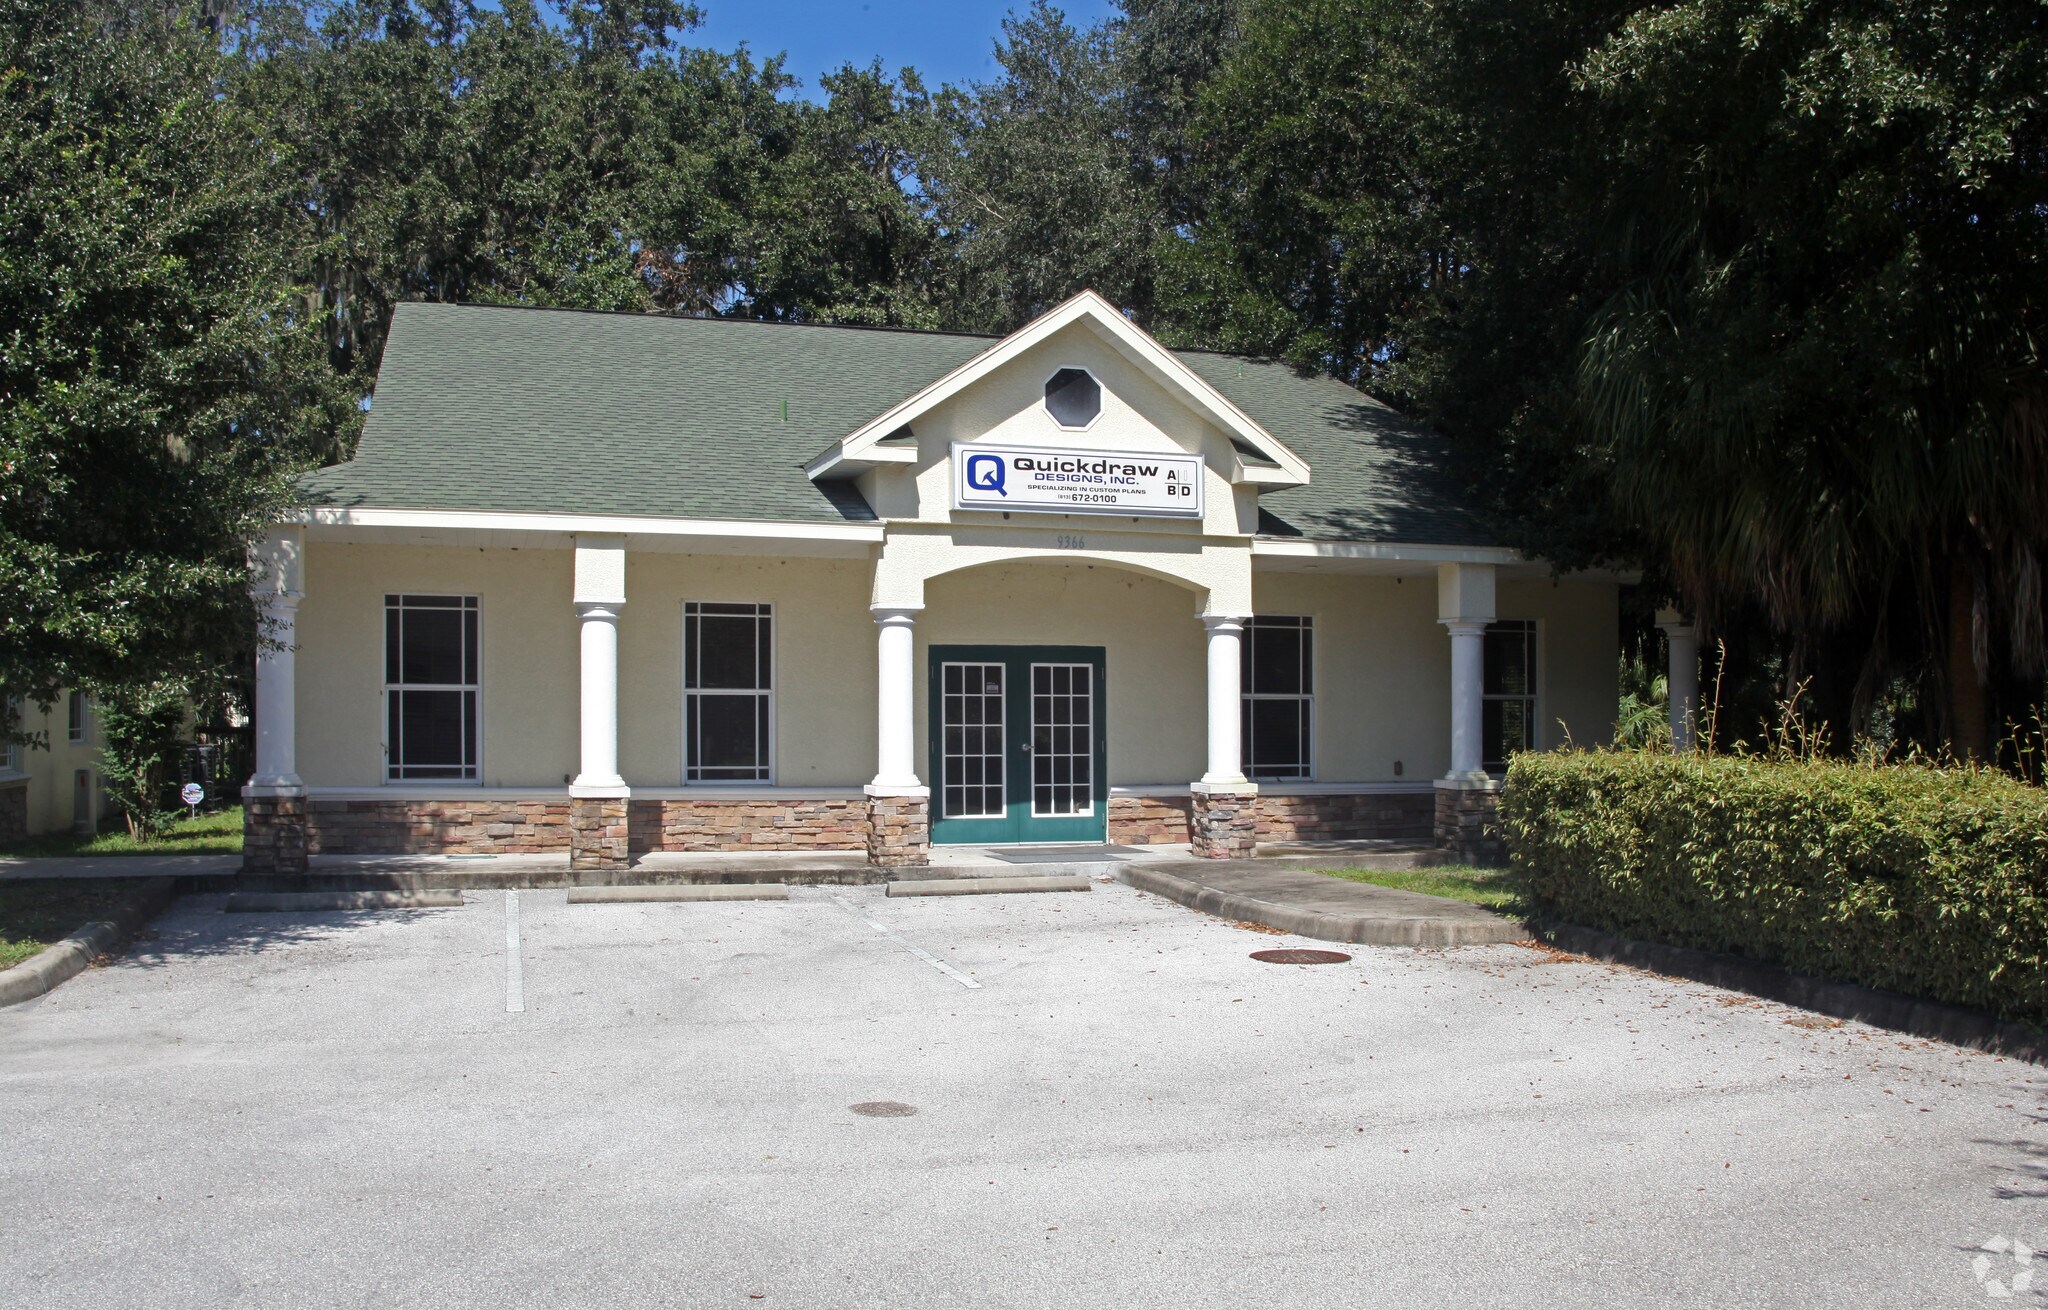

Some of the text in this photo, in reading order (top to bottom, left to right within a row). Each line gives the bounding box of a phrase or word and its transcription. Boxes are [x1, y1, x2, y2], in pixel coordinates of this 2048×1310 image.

[1013, 457, 1159, 477] Quickdraw
[1034, 472, 1139, 486] DESIGNS, INC.
[1167, 470, 1177, 480] A
[1027, 484, 1078, 492] SPECIALIZING
[1168, 485, 1190, 496] B D
[1071, 493, 1117, 503] 672-0100
[1057, 535, 1085, 549] 9366
